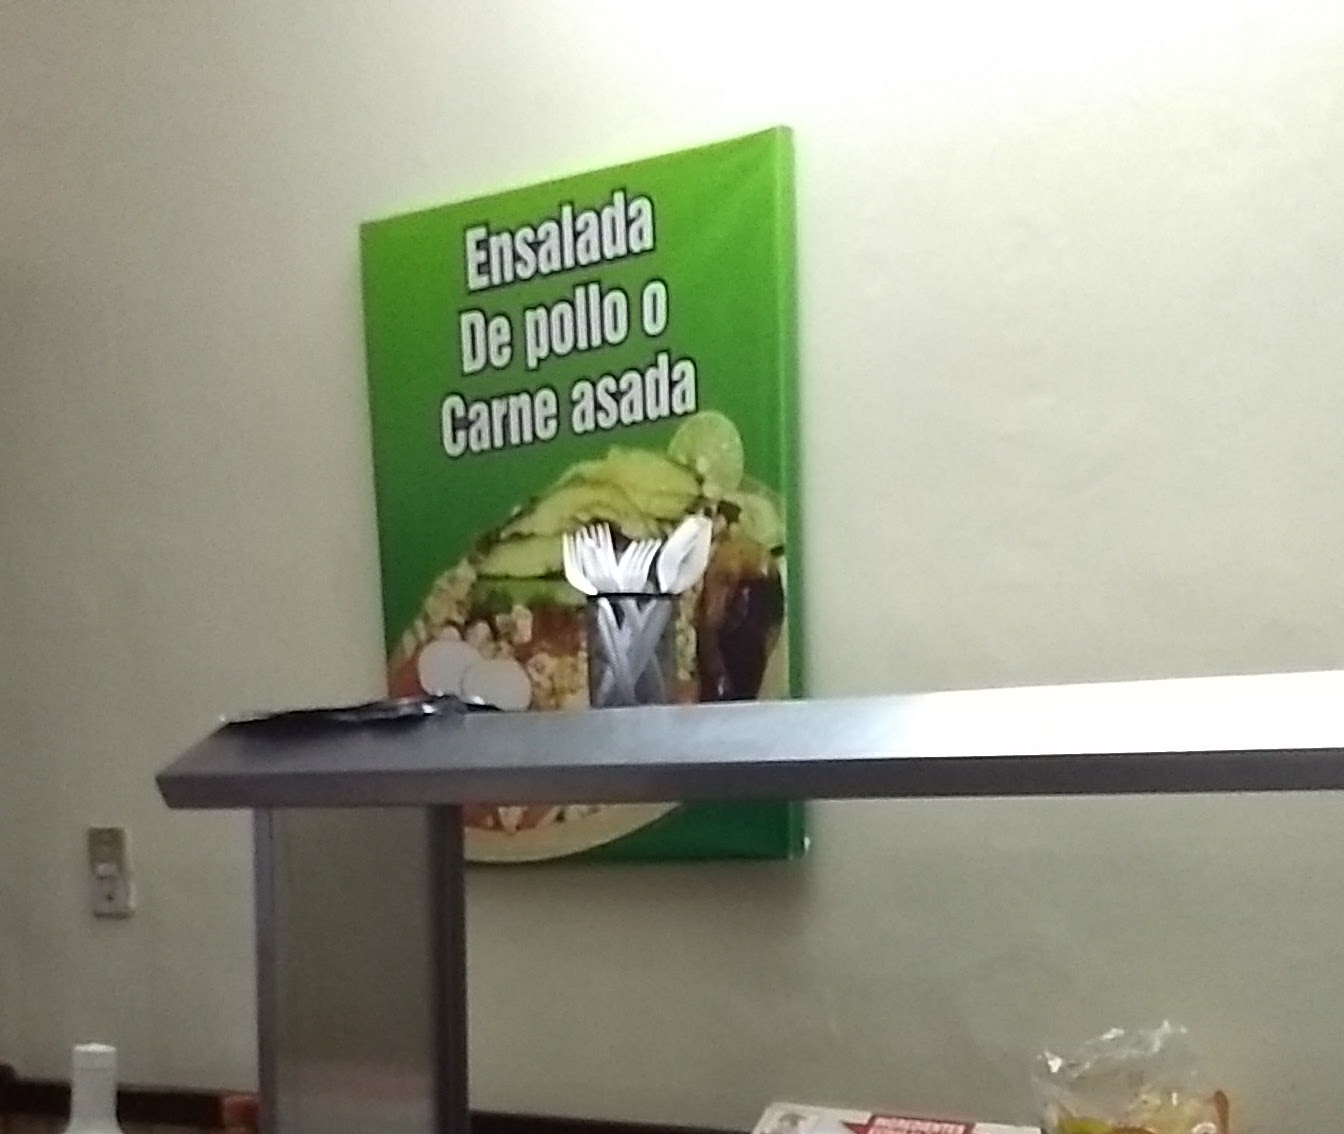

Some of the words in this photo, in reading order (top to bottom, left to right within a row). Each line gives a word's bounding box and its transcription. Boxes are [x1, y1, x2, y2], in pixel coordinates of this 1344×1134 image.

[464, 187, 655, 291] Ensalada
[459, 308, 513, 377] De
[525, 281, 629, 371] pollo
[641, 278, 670, 337] o
[440, 383, 559, 459] Carne
[570, 354, 698, 435] asada
